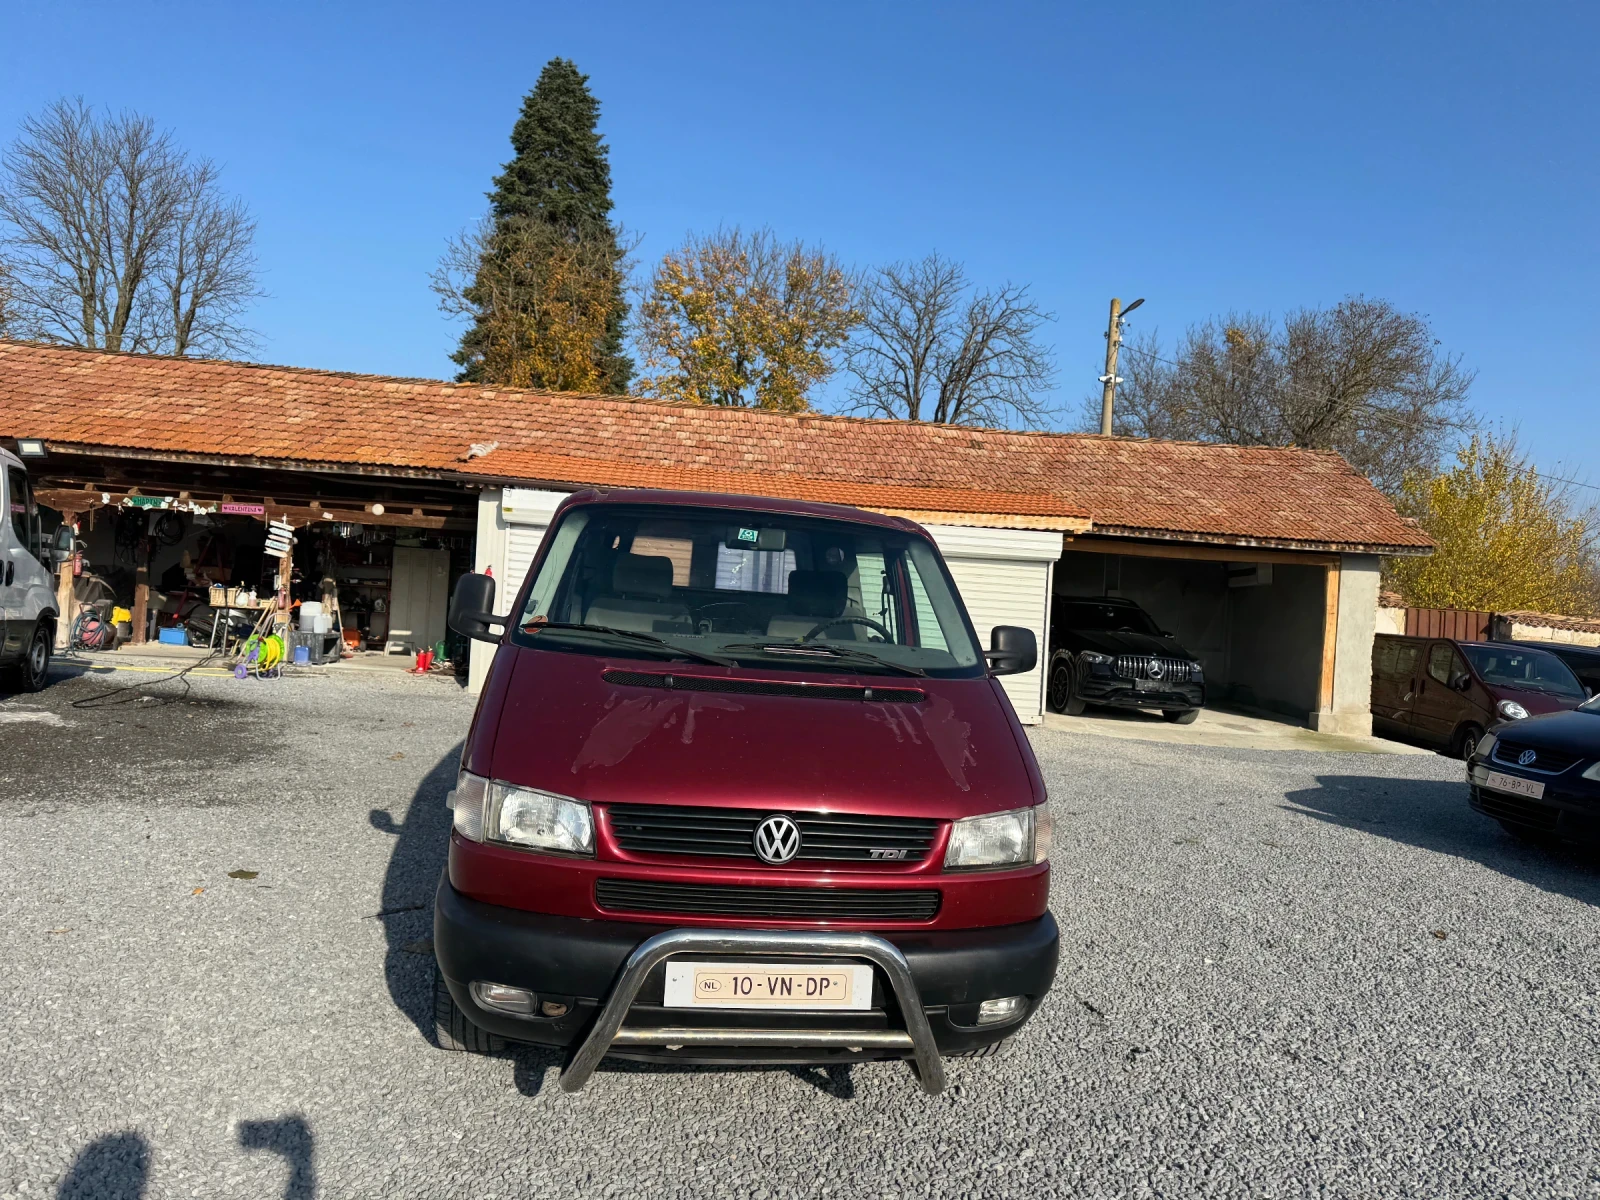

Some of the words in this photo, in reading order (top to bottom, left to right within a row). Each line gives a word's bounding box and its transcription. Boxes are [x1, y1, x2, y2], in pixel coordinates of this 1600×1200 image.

[755, 816, 801, 863] VW
[869, 849, 908, 859] TDI
[704, 981, 718, 990] NL
[732, 976, 831, 996] 10-VN-DP
